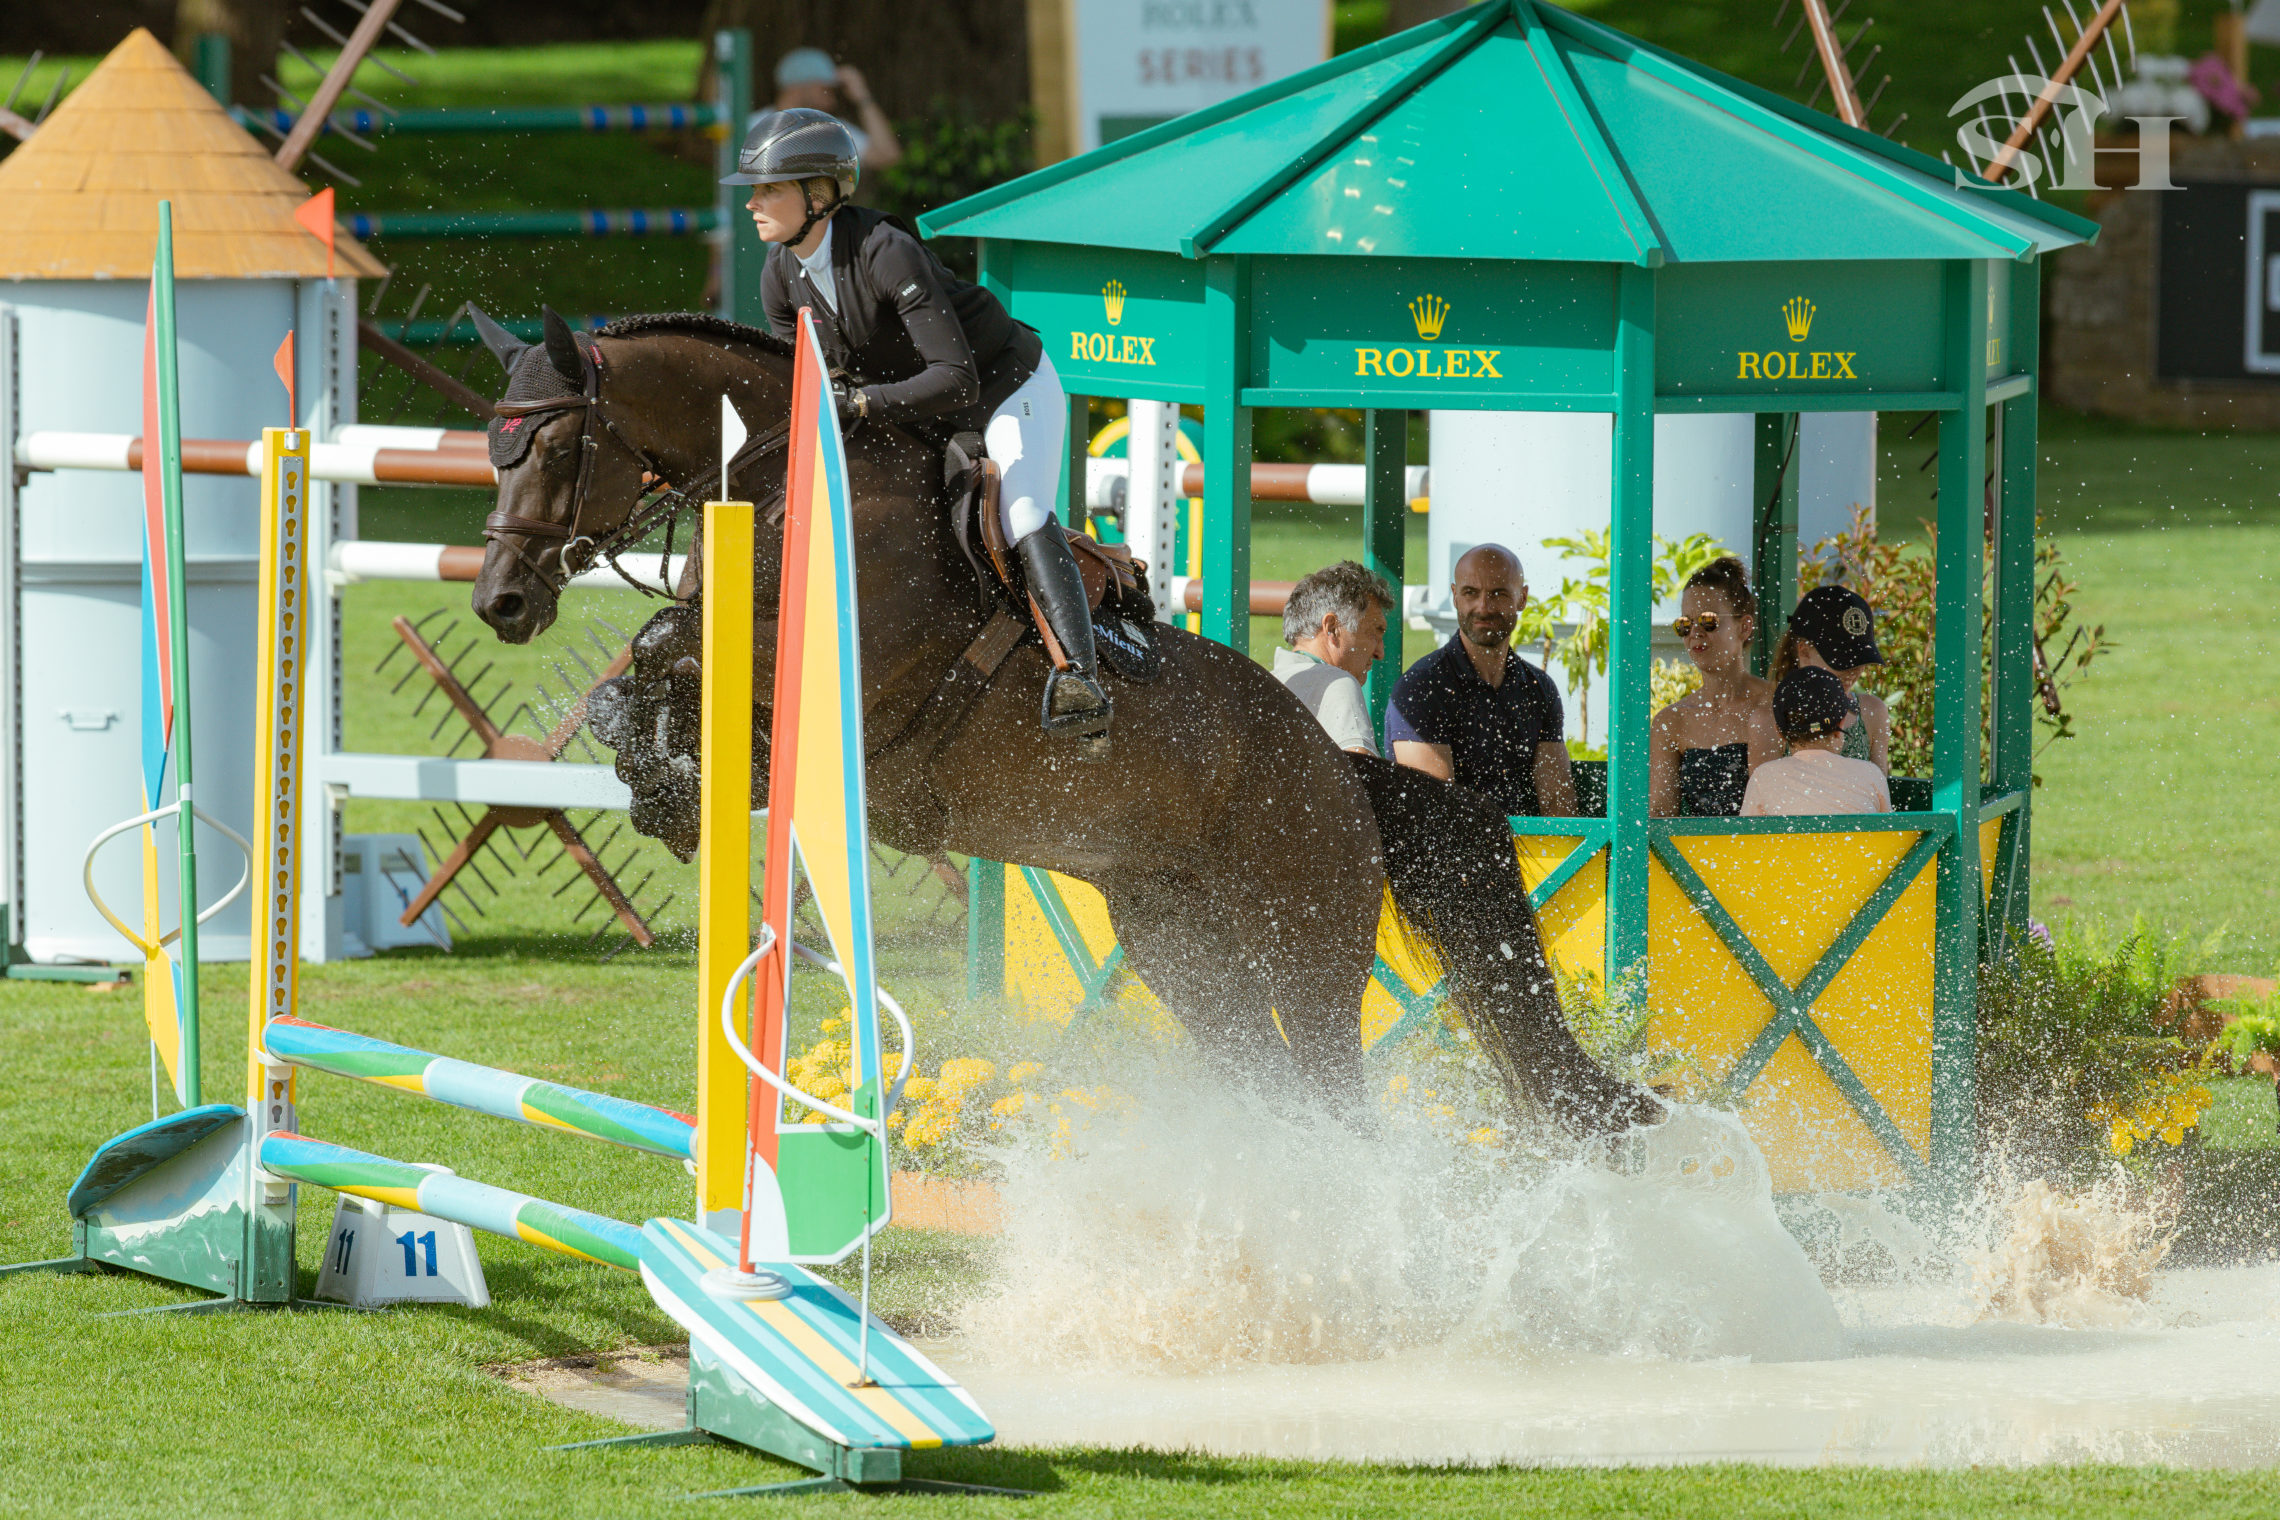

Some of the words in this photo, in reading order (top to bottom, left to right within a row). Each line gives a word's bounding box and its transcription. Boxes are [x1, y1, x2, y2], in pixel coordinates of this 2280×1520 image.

[1138, 46, 1265, 86] SERIES
[1070, 331, 1156, 365] ROLEX
[1355, 348, 1503, 378] ROLEX
[1737, 352, 1858, 379] ROLEX
[335, 1229, 355, 1275] 11
[396, 1231, 438, 1277] 11
